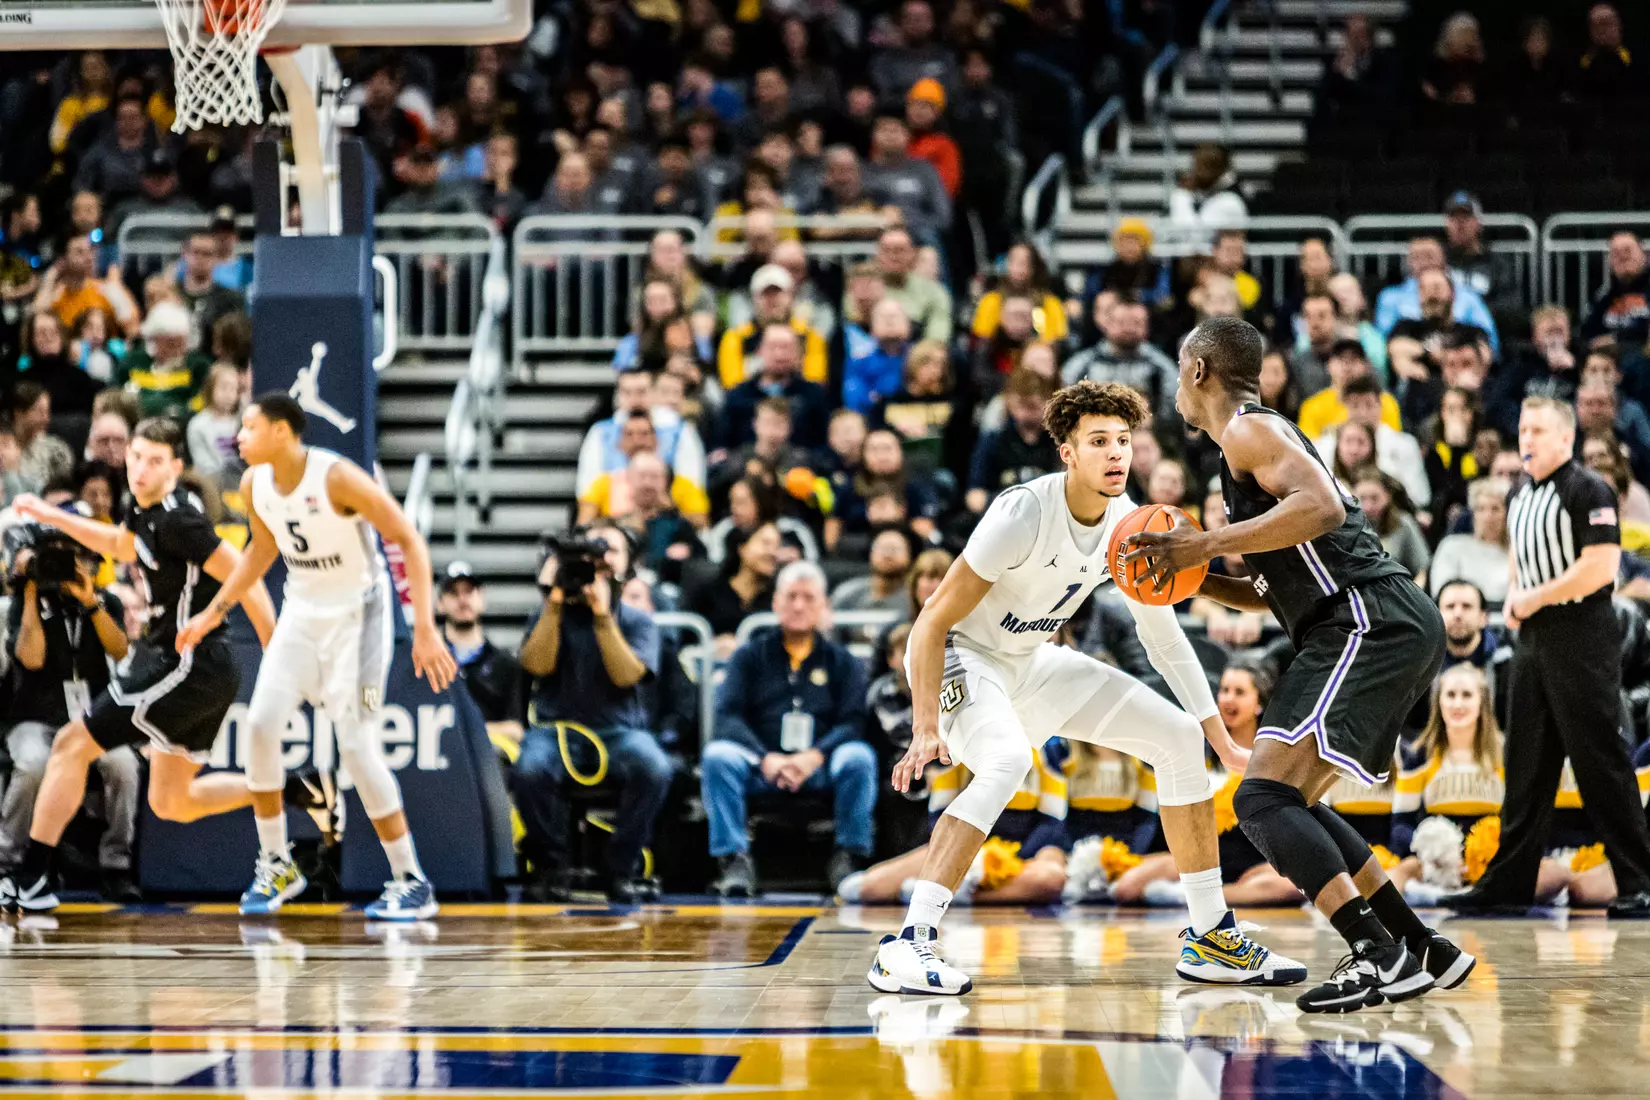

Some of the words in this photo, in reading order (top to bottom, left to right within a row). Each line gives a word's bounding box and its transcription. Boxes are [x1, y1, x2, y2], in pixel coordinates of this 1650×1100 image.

[286, 521, 309, 553] 5
[1079, 565, 1088, 573] AL
[1047, 583, 1083, 615] 1
